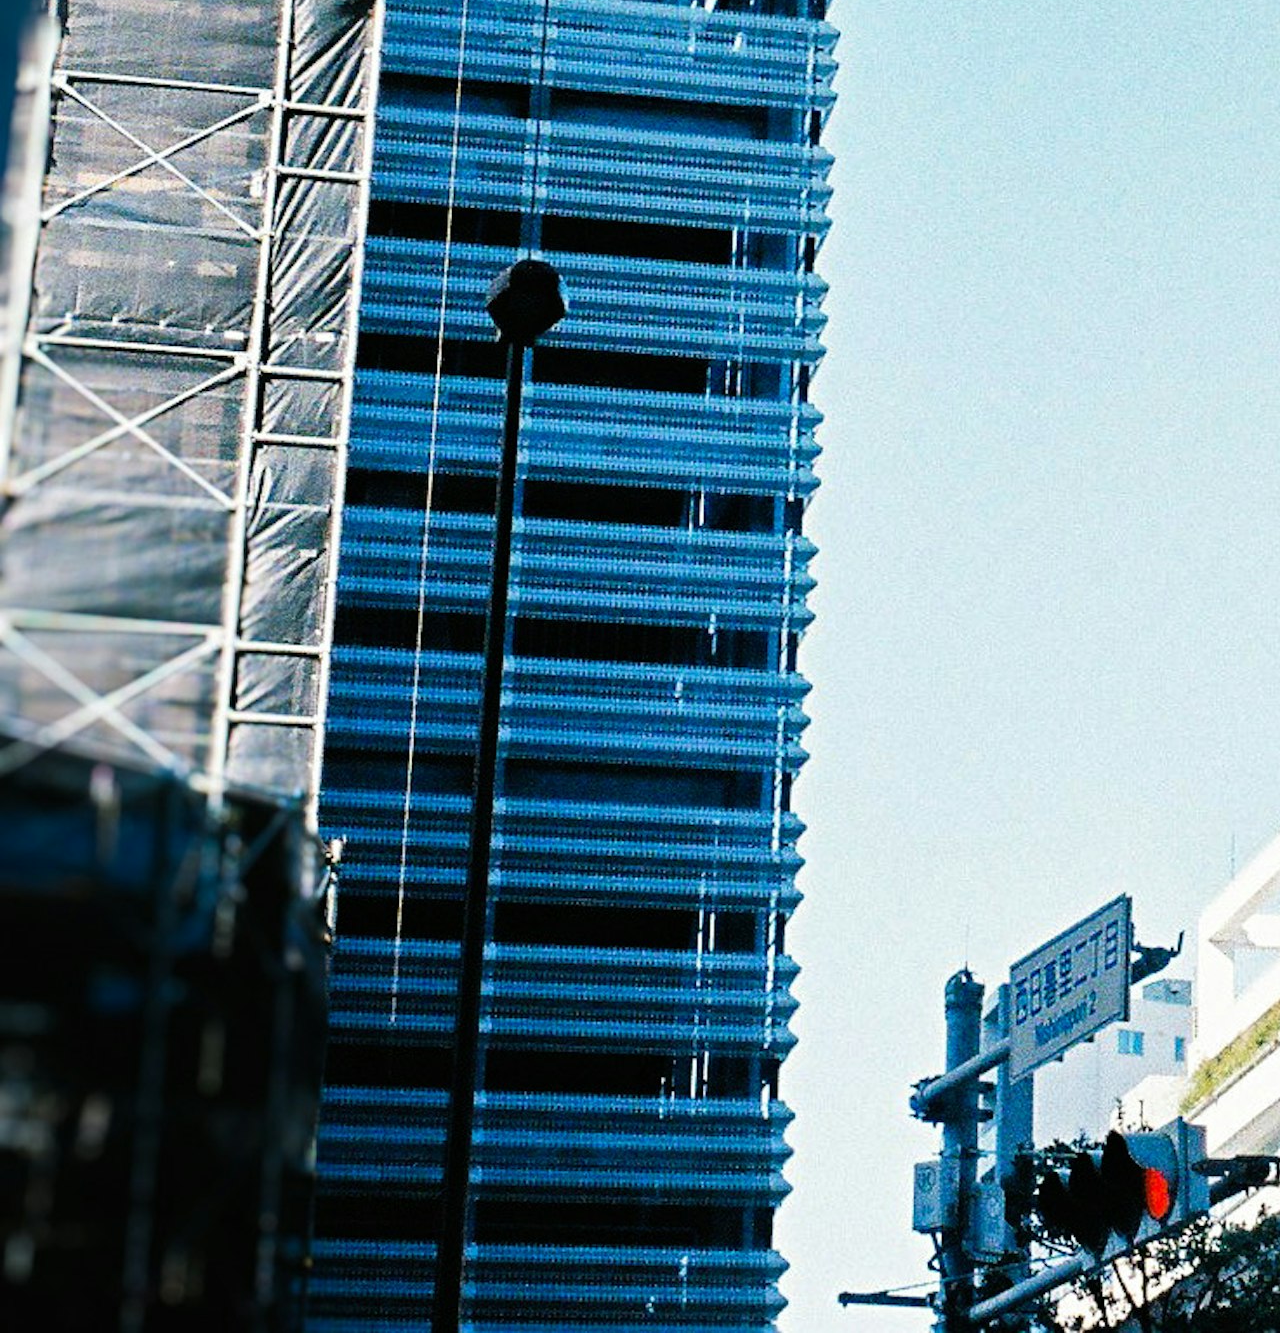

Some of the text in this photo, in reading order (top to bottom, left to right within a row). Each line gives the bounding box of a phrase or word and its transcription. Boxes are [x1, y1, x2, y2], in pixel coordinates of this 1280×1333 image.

[1016, 920, 1118, 1025] 西日暮里二丁目
[1088, 990, 1097, 1015] 2
